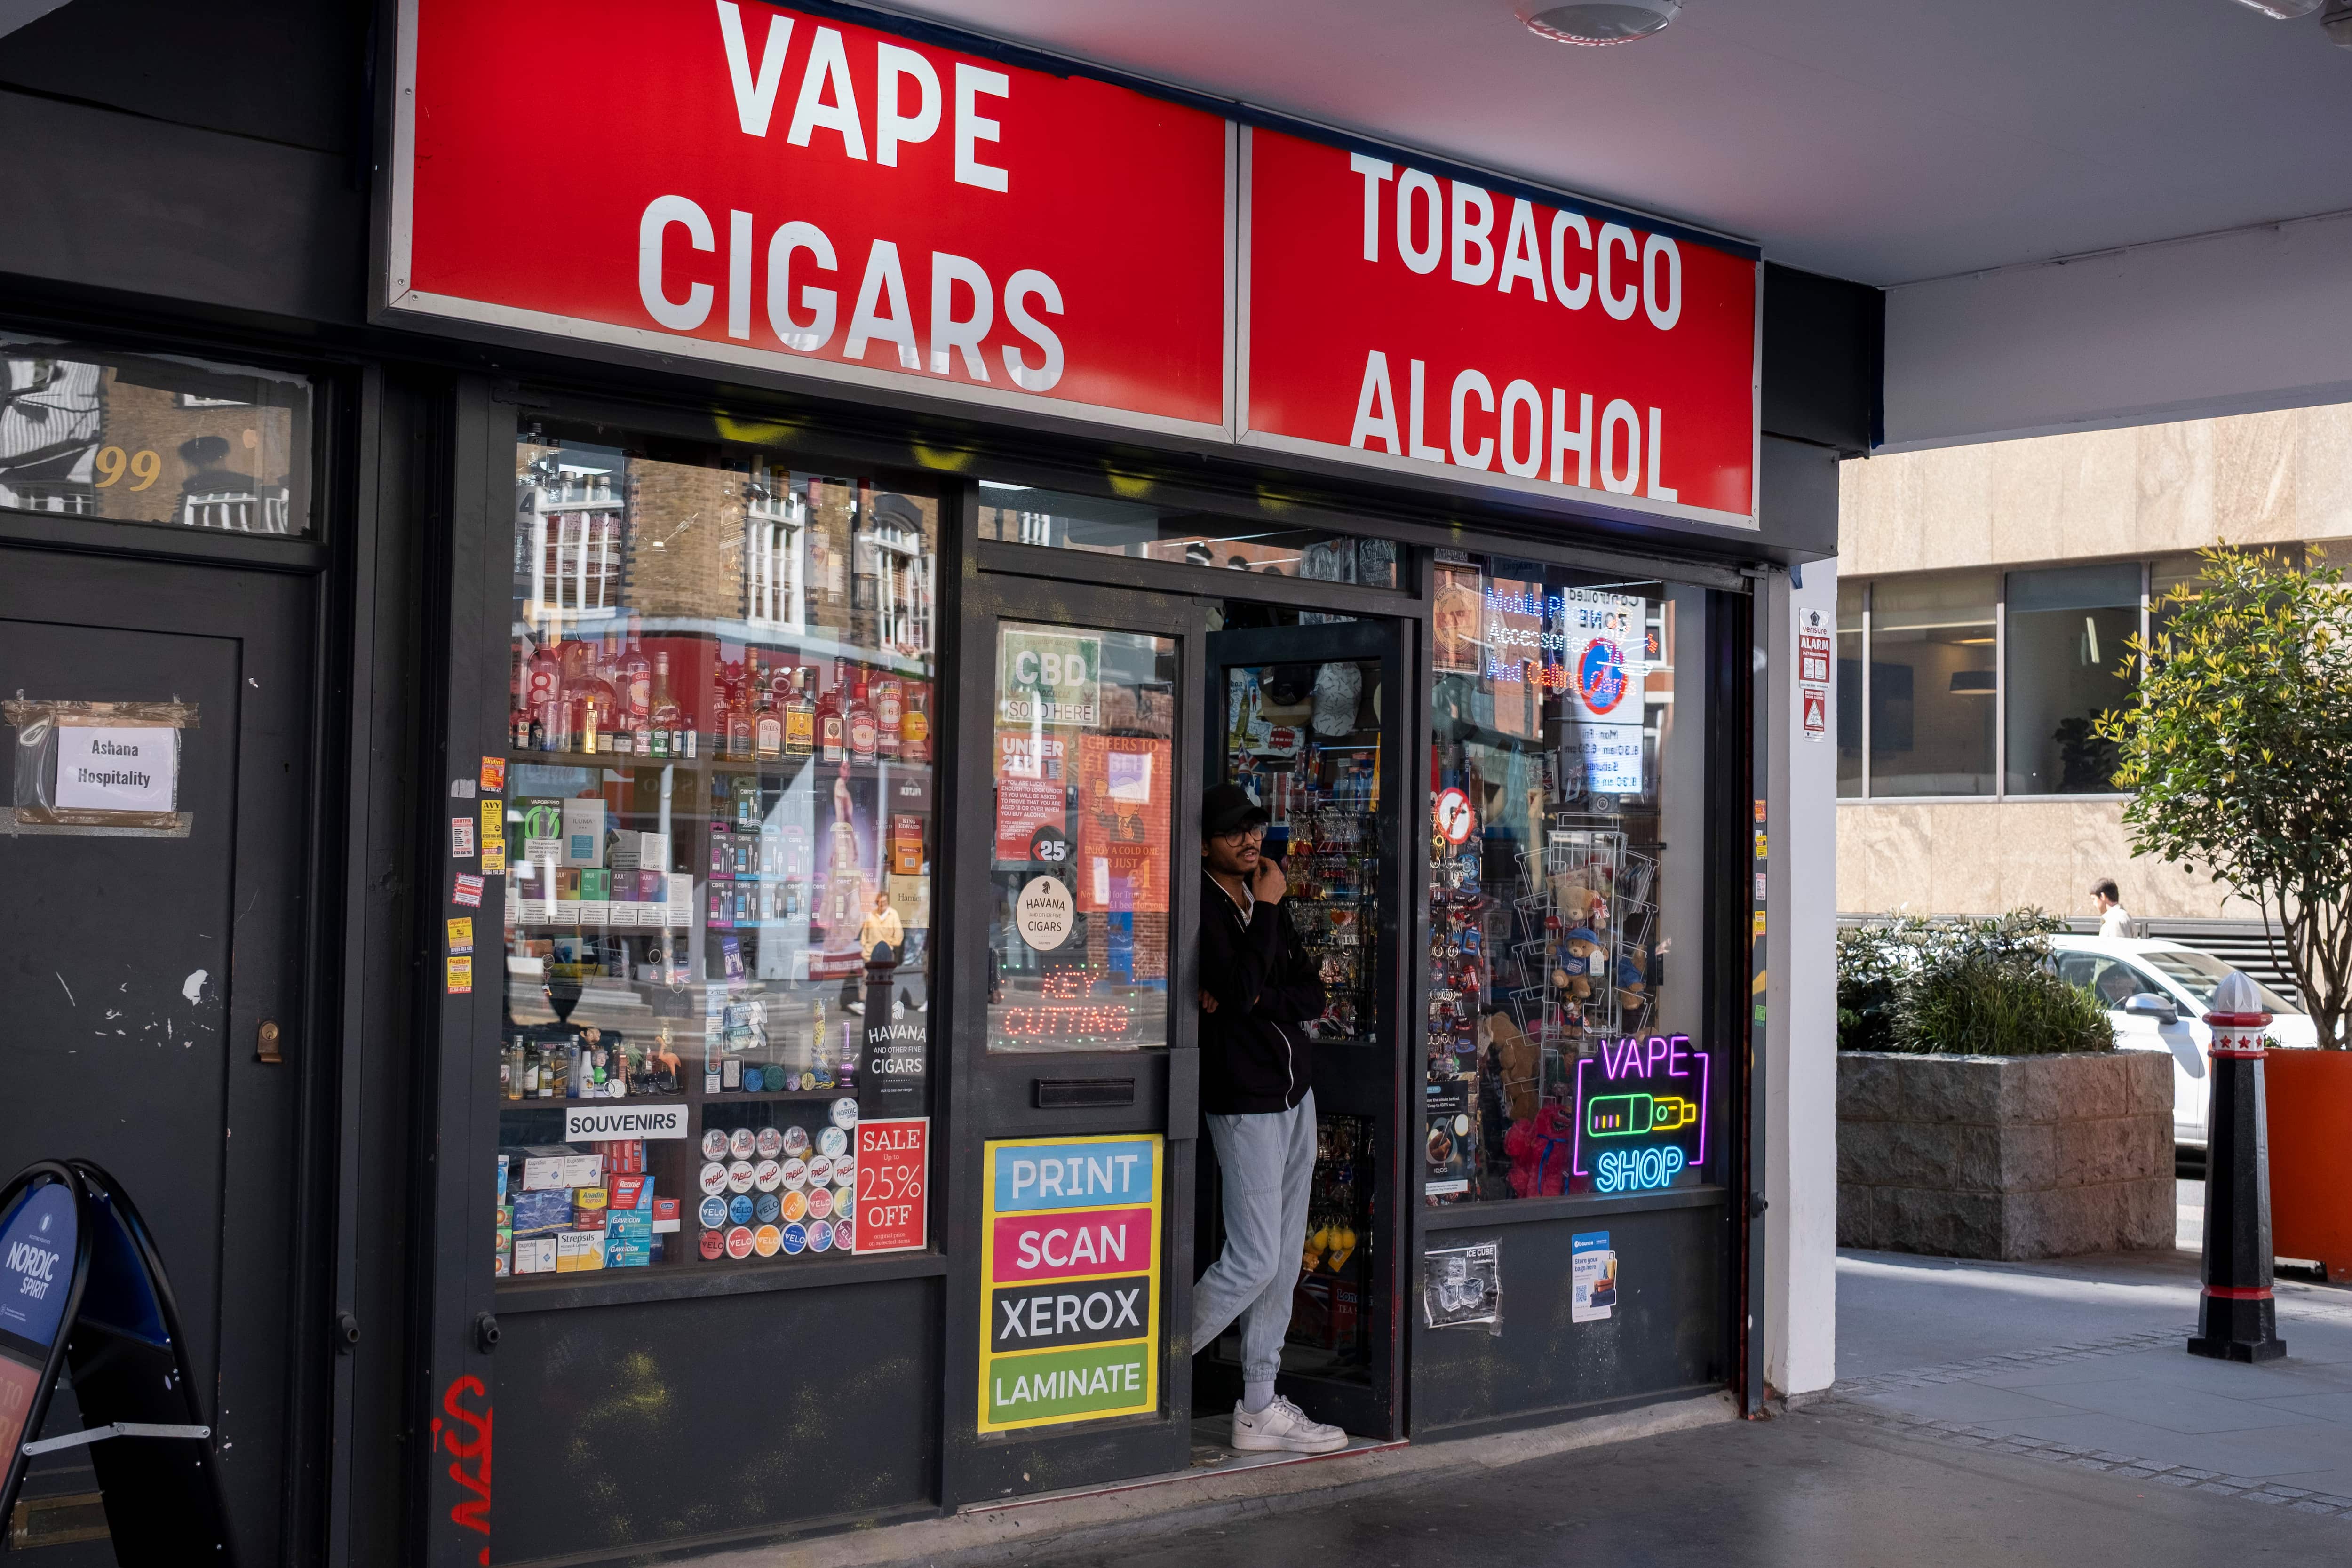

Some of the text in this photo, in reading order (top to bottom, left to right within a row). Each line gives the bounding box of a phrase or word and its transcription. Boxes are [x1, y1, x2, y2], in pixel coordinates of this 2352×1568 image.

[716, 0, 1009, 193] VAPE
[1351, 152, 1681, 330] TOBACCO
[639, 195, 1064, 391] CIGARS
[1350, 350, 1677, 503] ALCOHOL
[95, 446, 161, 491] 99
[1487, 587, 1543, 617] Mobile
[1803, 626, 1827, 635] verisure
[1801, 637, 1829, 651] ALARM
[1016, 651, 1086, 687] CBD
[1487, 657, 1521, 682] And
[1054, 704, 1091, 720] HERE
[92, 740, 139, 756] Ashana
[1087, 737, 1159, 752] CHEERS TO
[1084, 753, 1102, 772] £1
[78, 768, 150, 788] Hospitality
[1041, 840, 1065, 861] 25
[1084, 846, 1160, 855] ENJOY A COLD ONE
[1114, 858, 1138, 868] JUST
[1126, 859, 1152, 888] £1
[898, 893, 921, 902] Hamlet
[1026, 898, 1065, 911] HAVANA
[1028, 921, 1062, 932] CIGARS
[1041, 971, 1099, 999] KEY
[1005, 1005, 1128, 1035] CUTTING
[868, 1025, 927, 1043] HAVANA
[872, 1058, 922, 1074] CIGARS
[1601, 1035, 1690, 1080] VAPE
[570, 1113, 676, 1133] SOUVENIRS
[836, 1108, 857, 1118] NORDIC
[863, 1130, 920, 1152] SALE
[705, 1170, 724, 1187] PABLO
[759, 1166, 777, 1185] PABLO
[811, 1163, 829, 1178] PABLO
[1012, 1155, 1138, 1199] PRINT
[1596, 1146, 1683, 1192] SHOP
[860, 1164, 921, 1201] 25%
[702, 1208, 725, 1217] VELO
[758, 1201, 779, 1215] VELO
[786, 1195, 803, 1216] VELO
[868, 1205, 912, 1227] OFF
[561, 1234, 595, 1243] Strepsils
[702, 1241, 723, 1249] VELO
[757, 1236, 779, 1245] VELO
[810, 1230, 831, 1242] VELO
[1017, 1224, 1126, 1269] SCAN
[1477, 1248, 1493, 1256] CUBE
[6, 1241, 59, 1281] NORDIC
[20, 1276, 49, 1300] SPIRIT
[1000, 1289, 1140, 1340] XEROX
[996, 1362, 1141, 1406] LAMINATE
